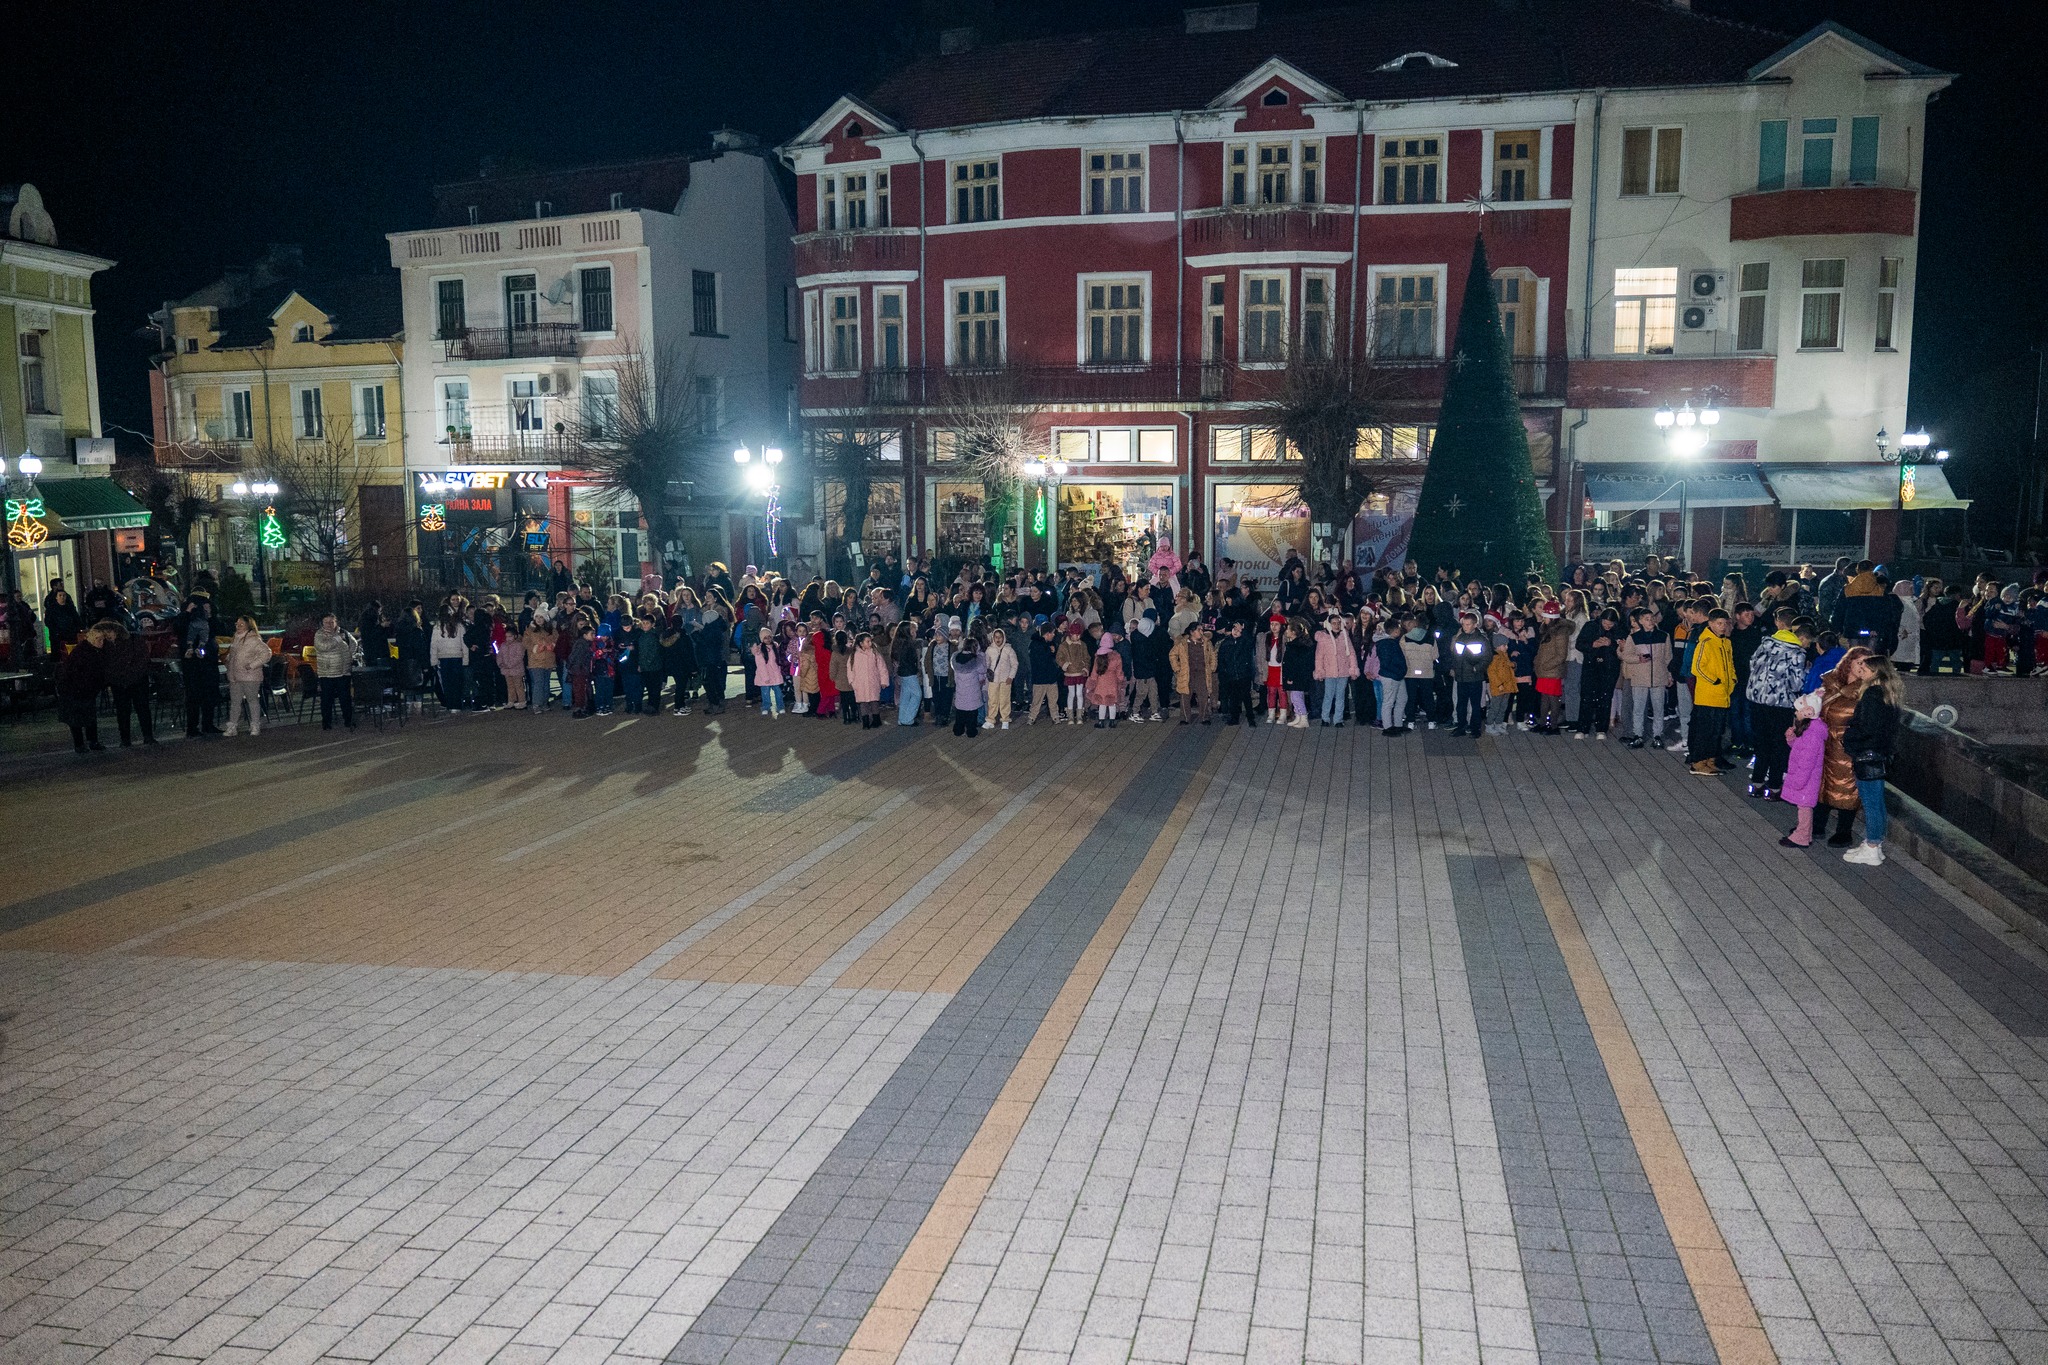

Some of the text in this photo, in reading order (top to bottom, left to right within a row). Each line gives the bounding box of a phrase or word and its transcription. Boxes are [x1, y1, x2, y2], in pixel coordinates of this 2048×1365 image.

[446, 499, 492, 510] РАЛНА ЗАЛА
[527, 533, 547, 545] SLY
[1234, 560, 1270, 570] токи
[1240, 573, 1280, 586] бта
[292, 584, 316, 592] Party
